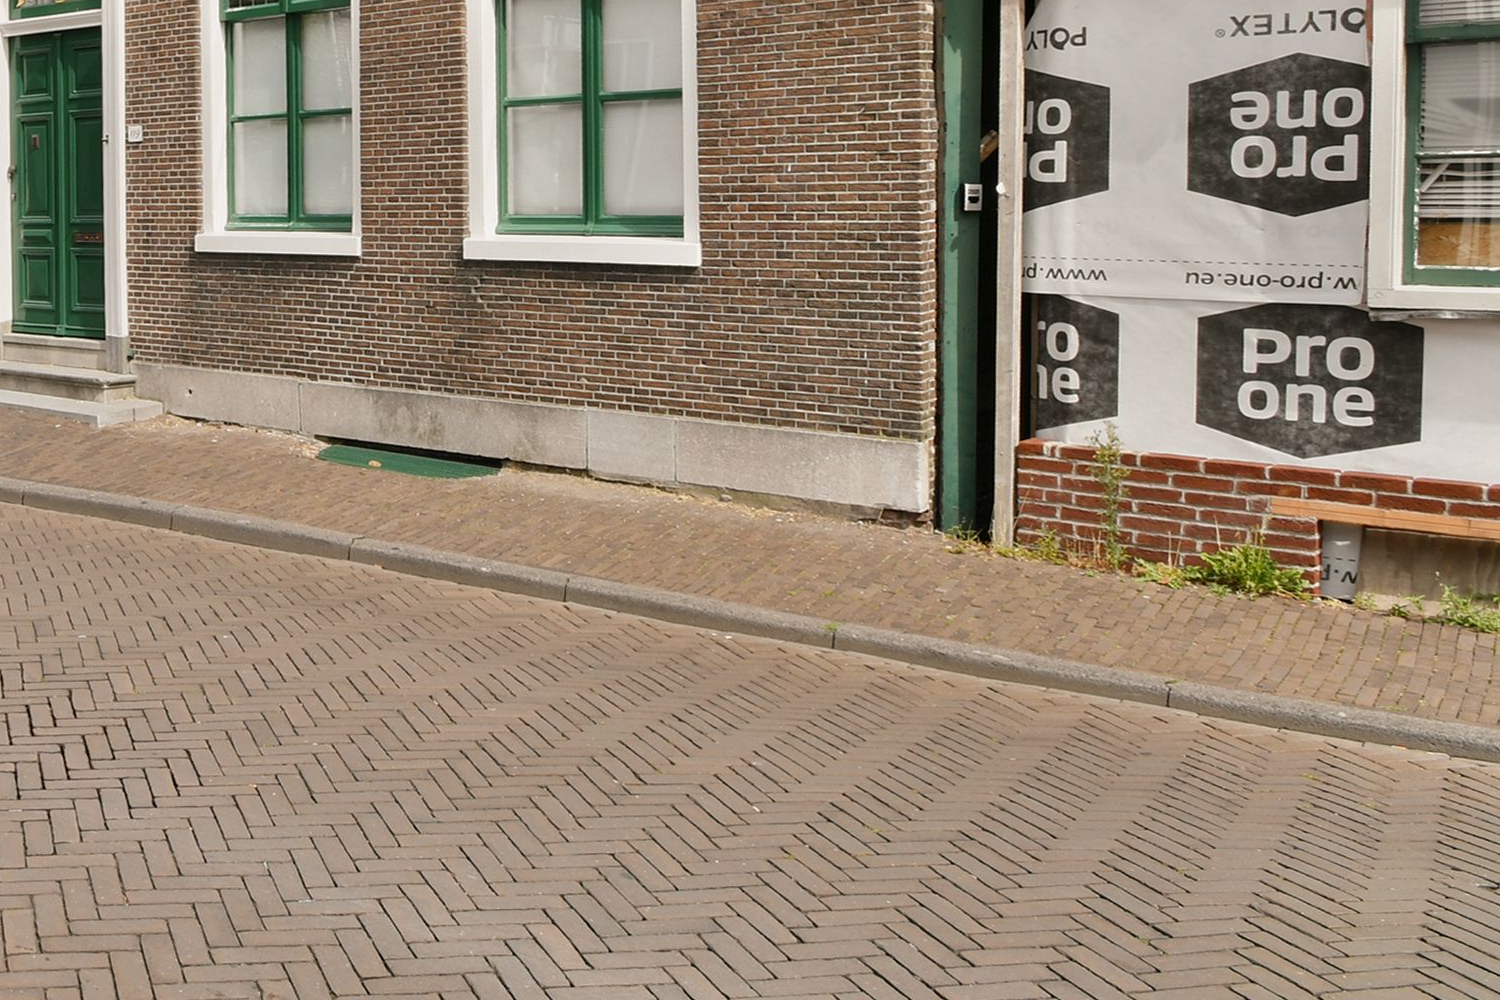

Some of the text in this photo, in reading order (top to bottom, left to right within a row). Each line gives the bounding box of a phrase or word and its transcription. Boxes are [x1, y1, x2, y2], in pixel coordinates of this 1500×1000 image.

[1026, 26, 1087, 51] POLY
[1229, 87, 1364, 131] one
[1230, 133, 1359, 182] Pro
[1242, 327, 1376, 382] Pro
[1237, 380, 1376, 428] one
